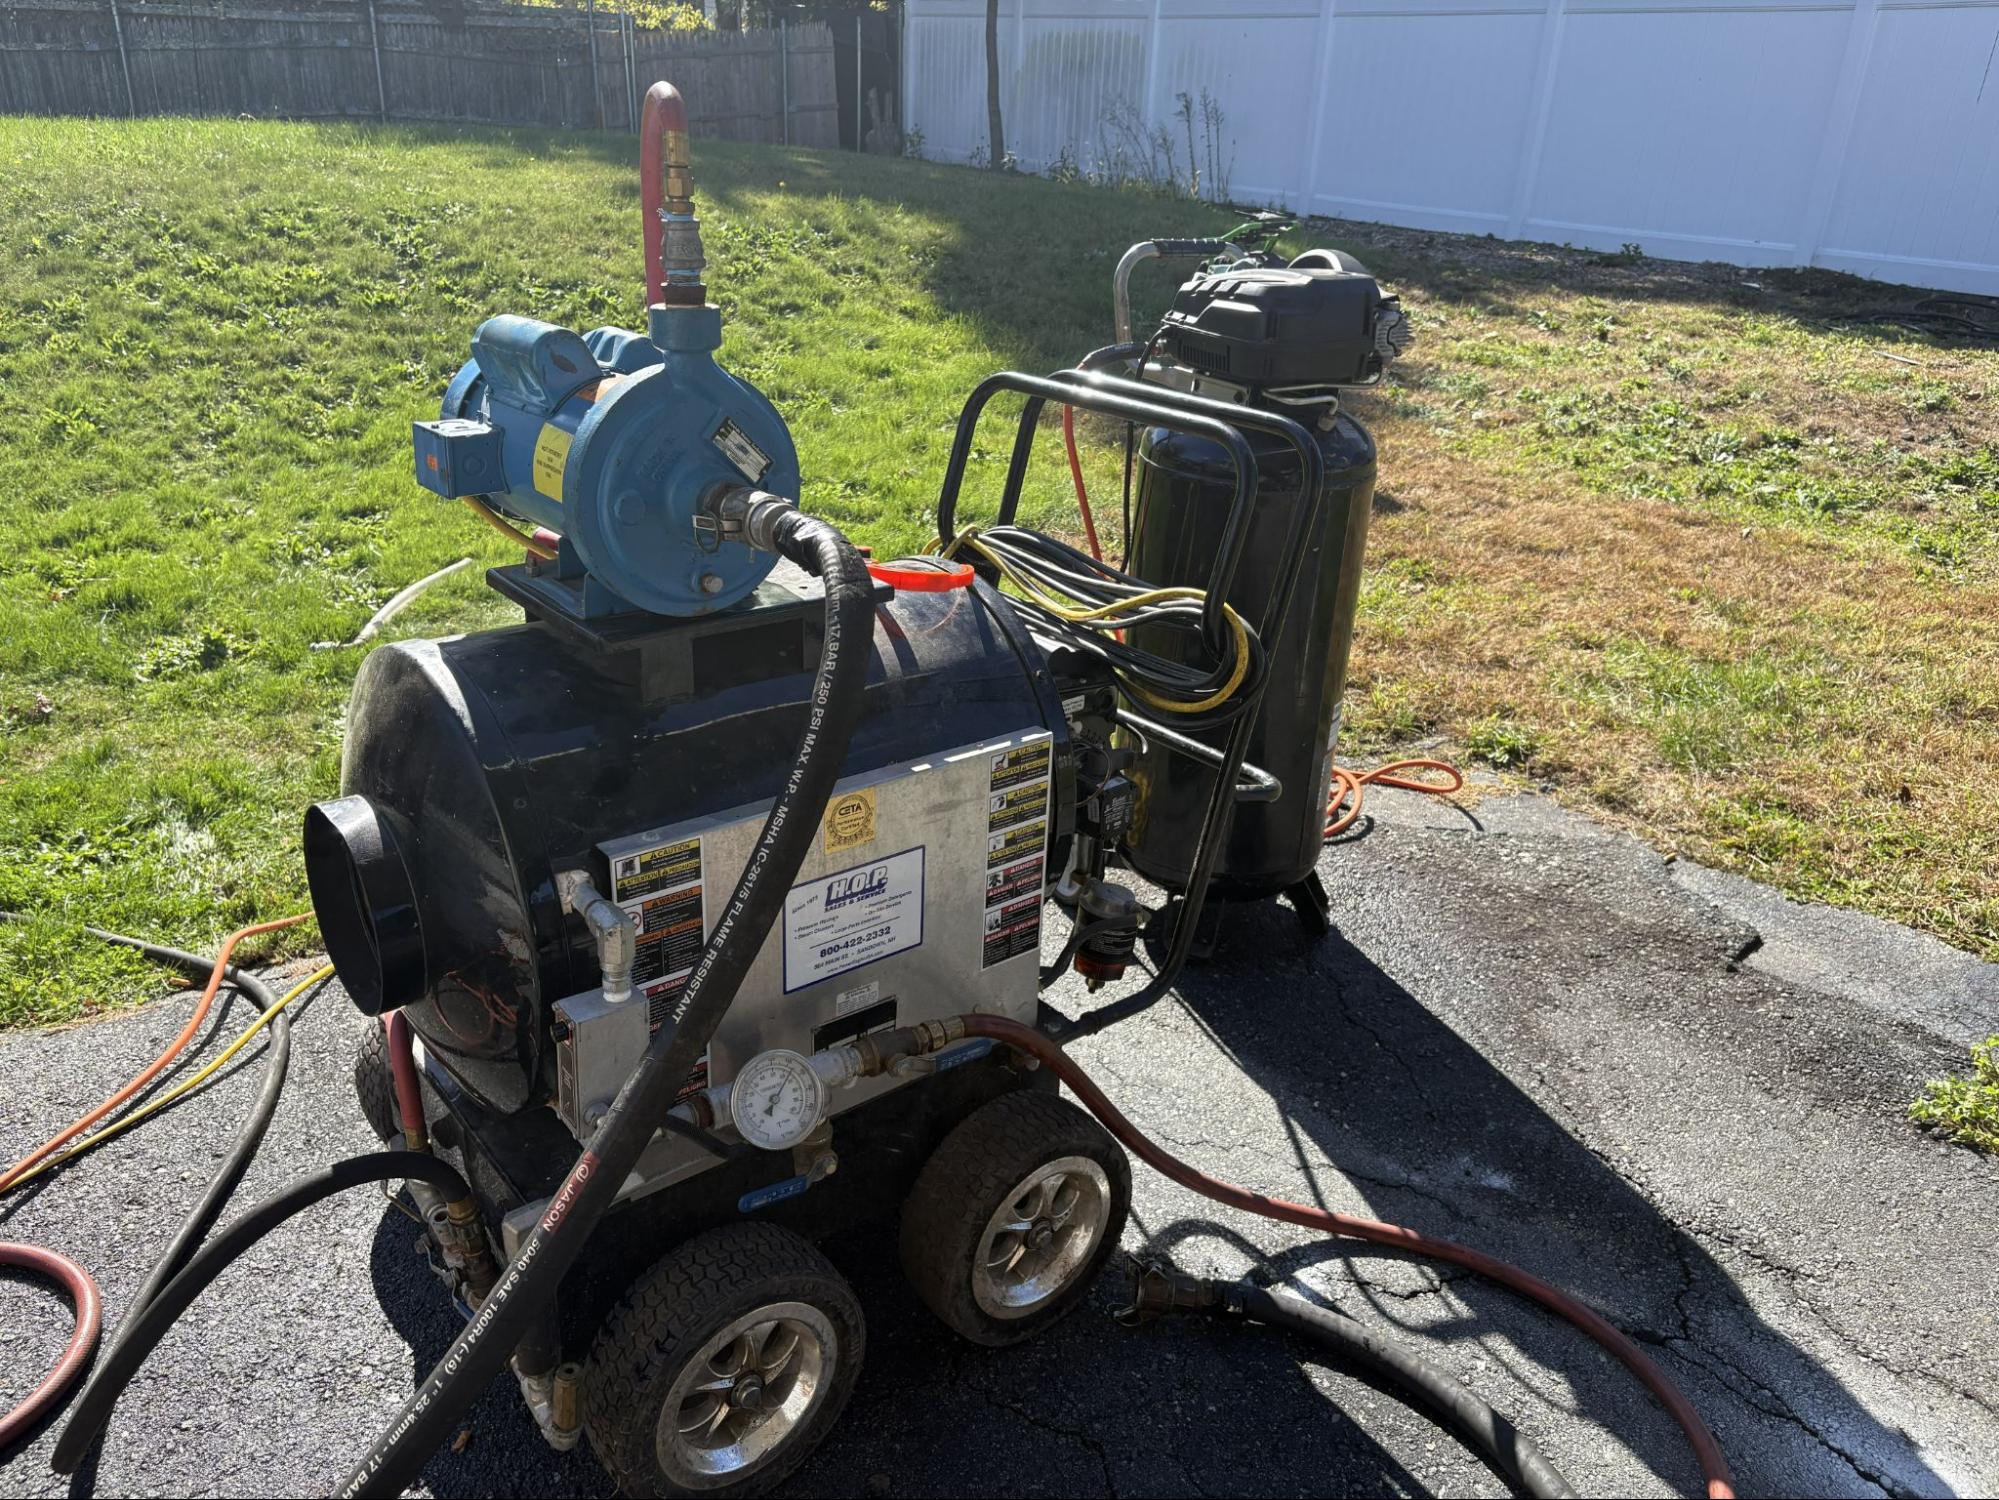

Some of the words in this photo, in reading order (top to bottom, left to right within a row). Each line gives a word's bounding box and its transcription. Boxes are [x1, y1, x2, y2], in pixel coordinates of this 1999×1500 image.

[830, 622, 841, 638] 17
[824, 641, 841, 671] BAR
[817, 681, 831, 705] 250
[809, 708, 825, 730] PSI
[796, 733, 817, 766] MAX.
[785, 769, 804, 794] W.P.
[764, 805, 789, 845] MSHA
[838, 802, 862, 816] CETA
[657, 842, 690, 857] CAUTION
[739, 849, 770, 900] IC-261/5
[657, 889, 694, 904] WARNING
[857, 888, 886, 903] SERVICE
[713, 902, 744, 948] FLAME
[820, 926, 891, 958] 800-422-2332
[672, 948, 718, 1025] RESISTANT
[543, 1184, 575, 1232] JASON
[517, 1238, 541, 1272] 5040
[496, 1271, 520, 1303] SAE
[467, 1302, 499, 1344] 100R4
[444, 1342, 470, 1375] (-16)
[388, 1393, 431, 1445] 25.4mm
[367, 1454, 383, 1473] 17
[341, 1470, 369, 1499] BAR
